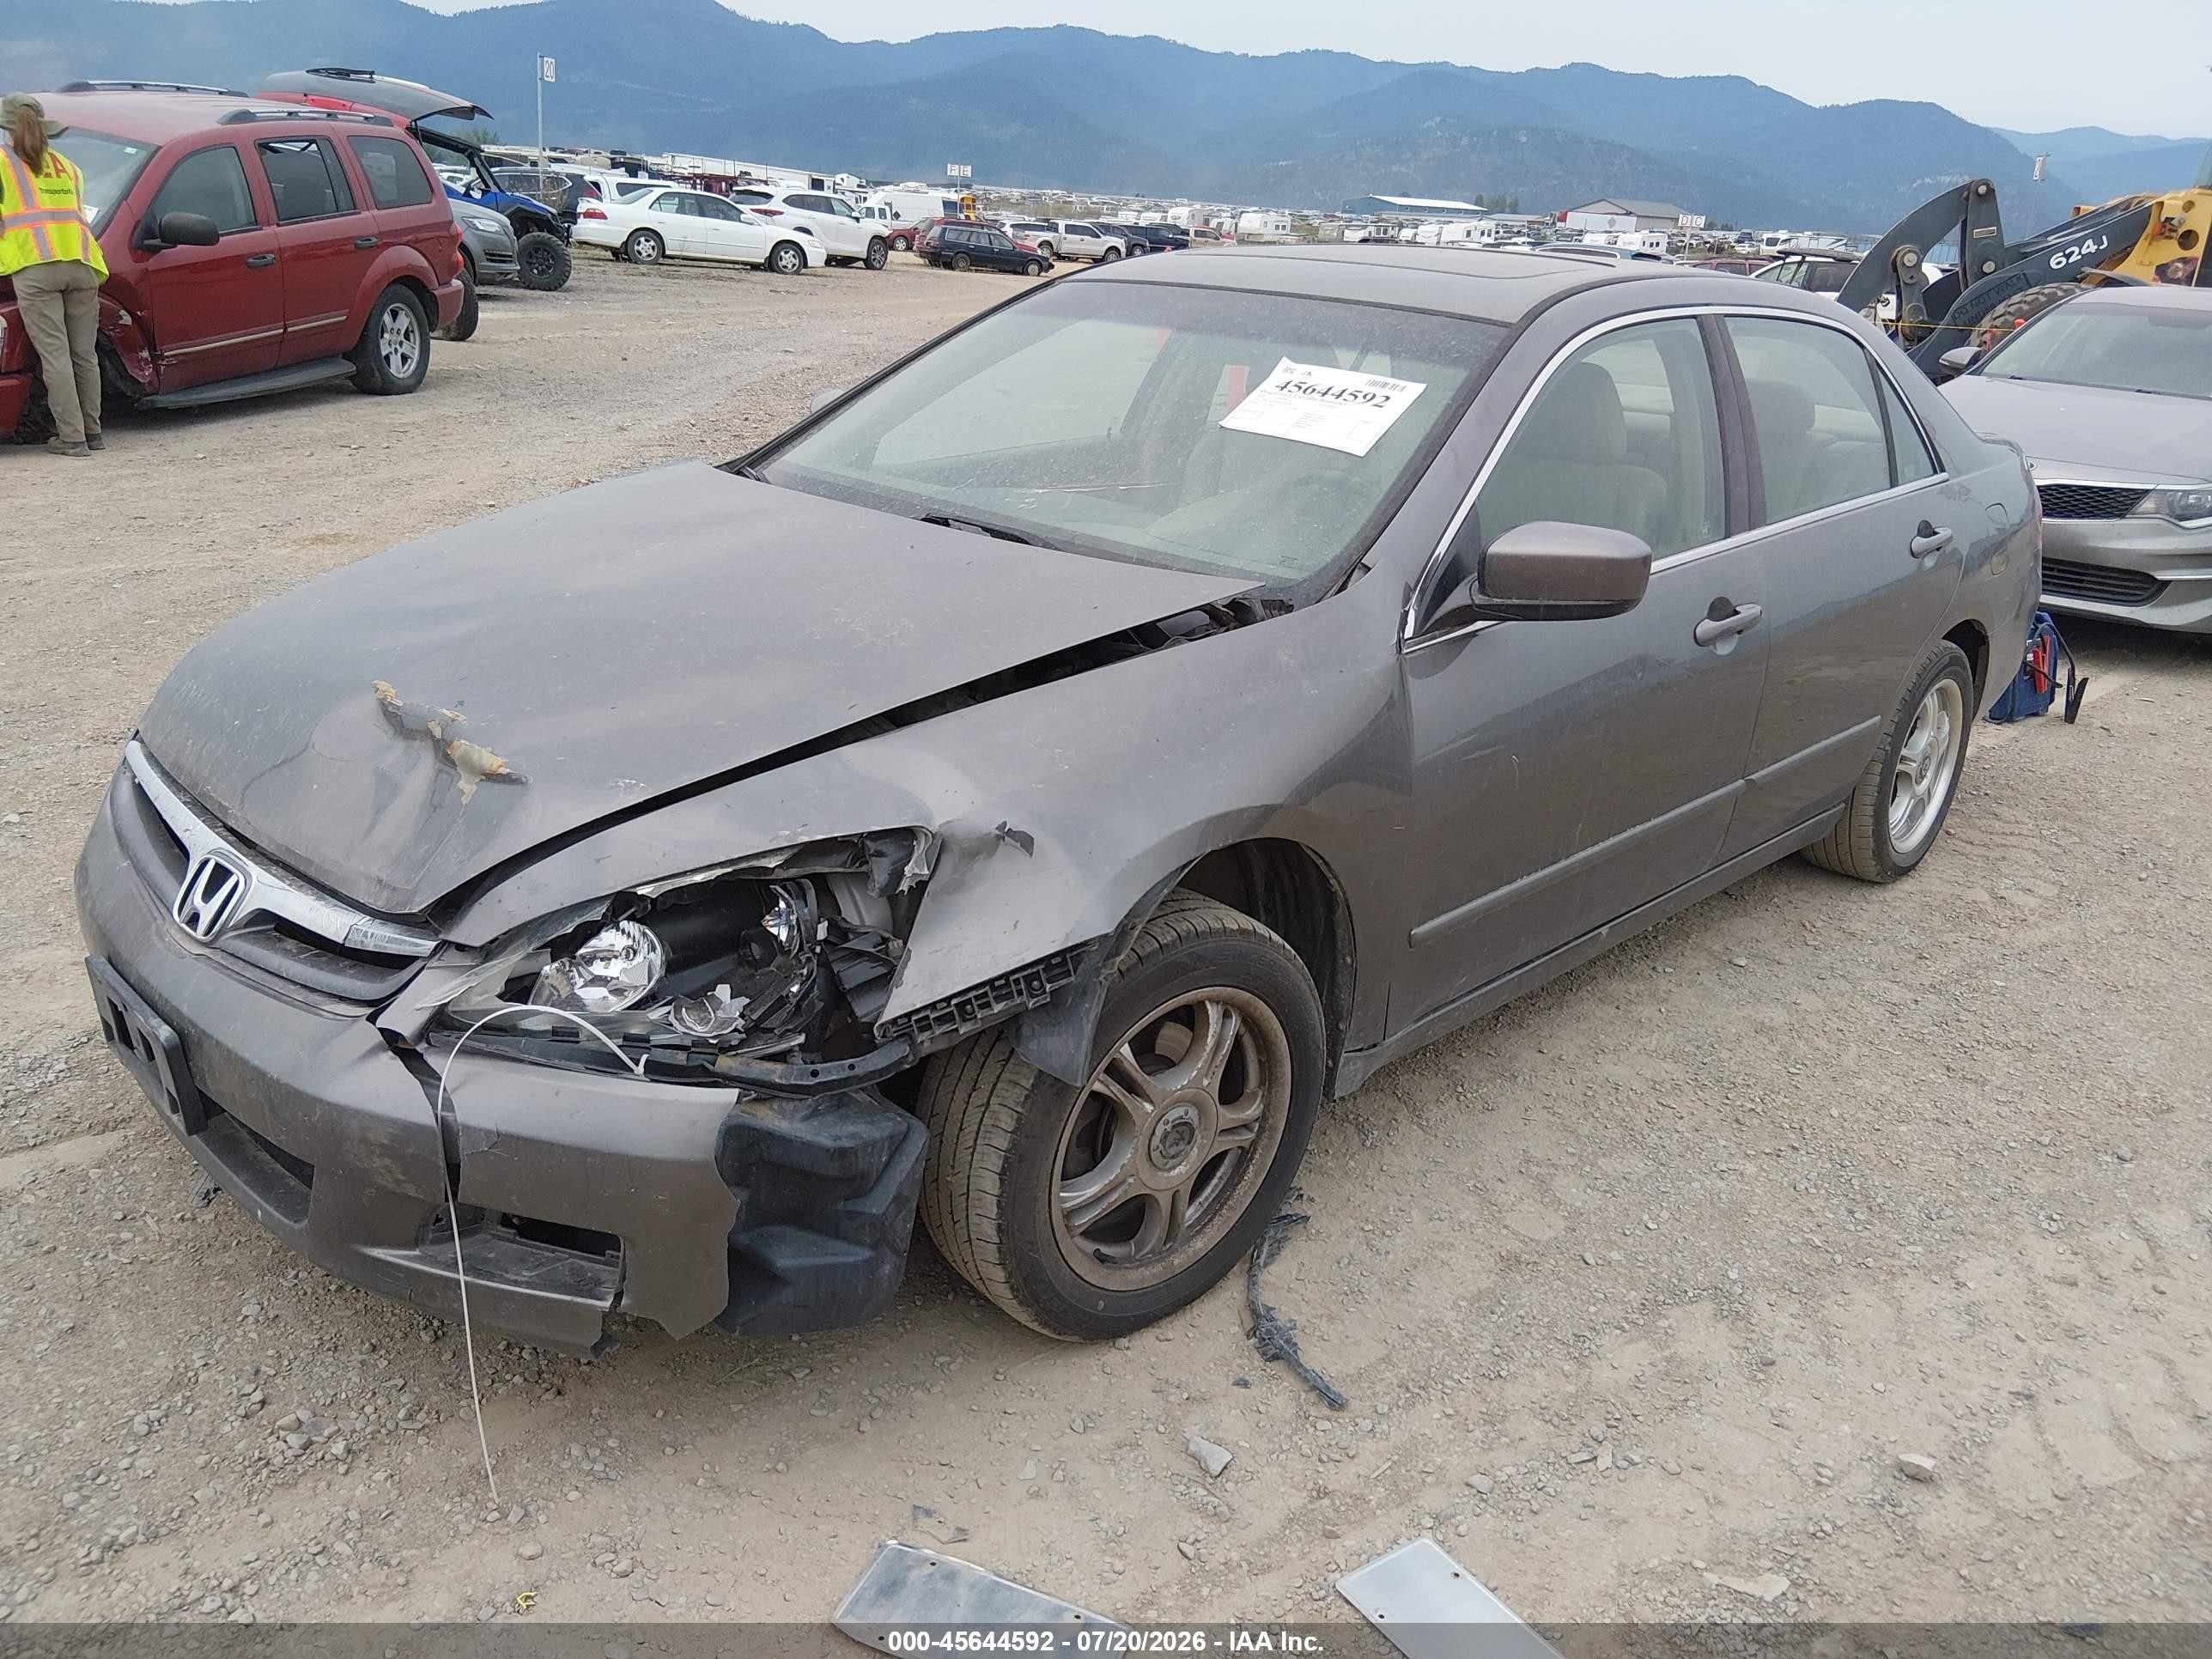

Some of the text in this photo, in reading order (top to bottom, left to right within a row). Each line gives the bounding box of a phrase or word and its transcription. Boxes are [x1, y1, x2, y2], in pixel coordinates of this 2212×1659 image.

[544, 60, 555, 79] 20
[950, 165, 956, 174] F
[962, 166, 969, 176] E
[1680, 216, 1689, 226] D
[1694, 216, 1703, 227] C
[2049, 234, 2109, 270] 624J
[1275, 380, 1391, 409] 45644592
